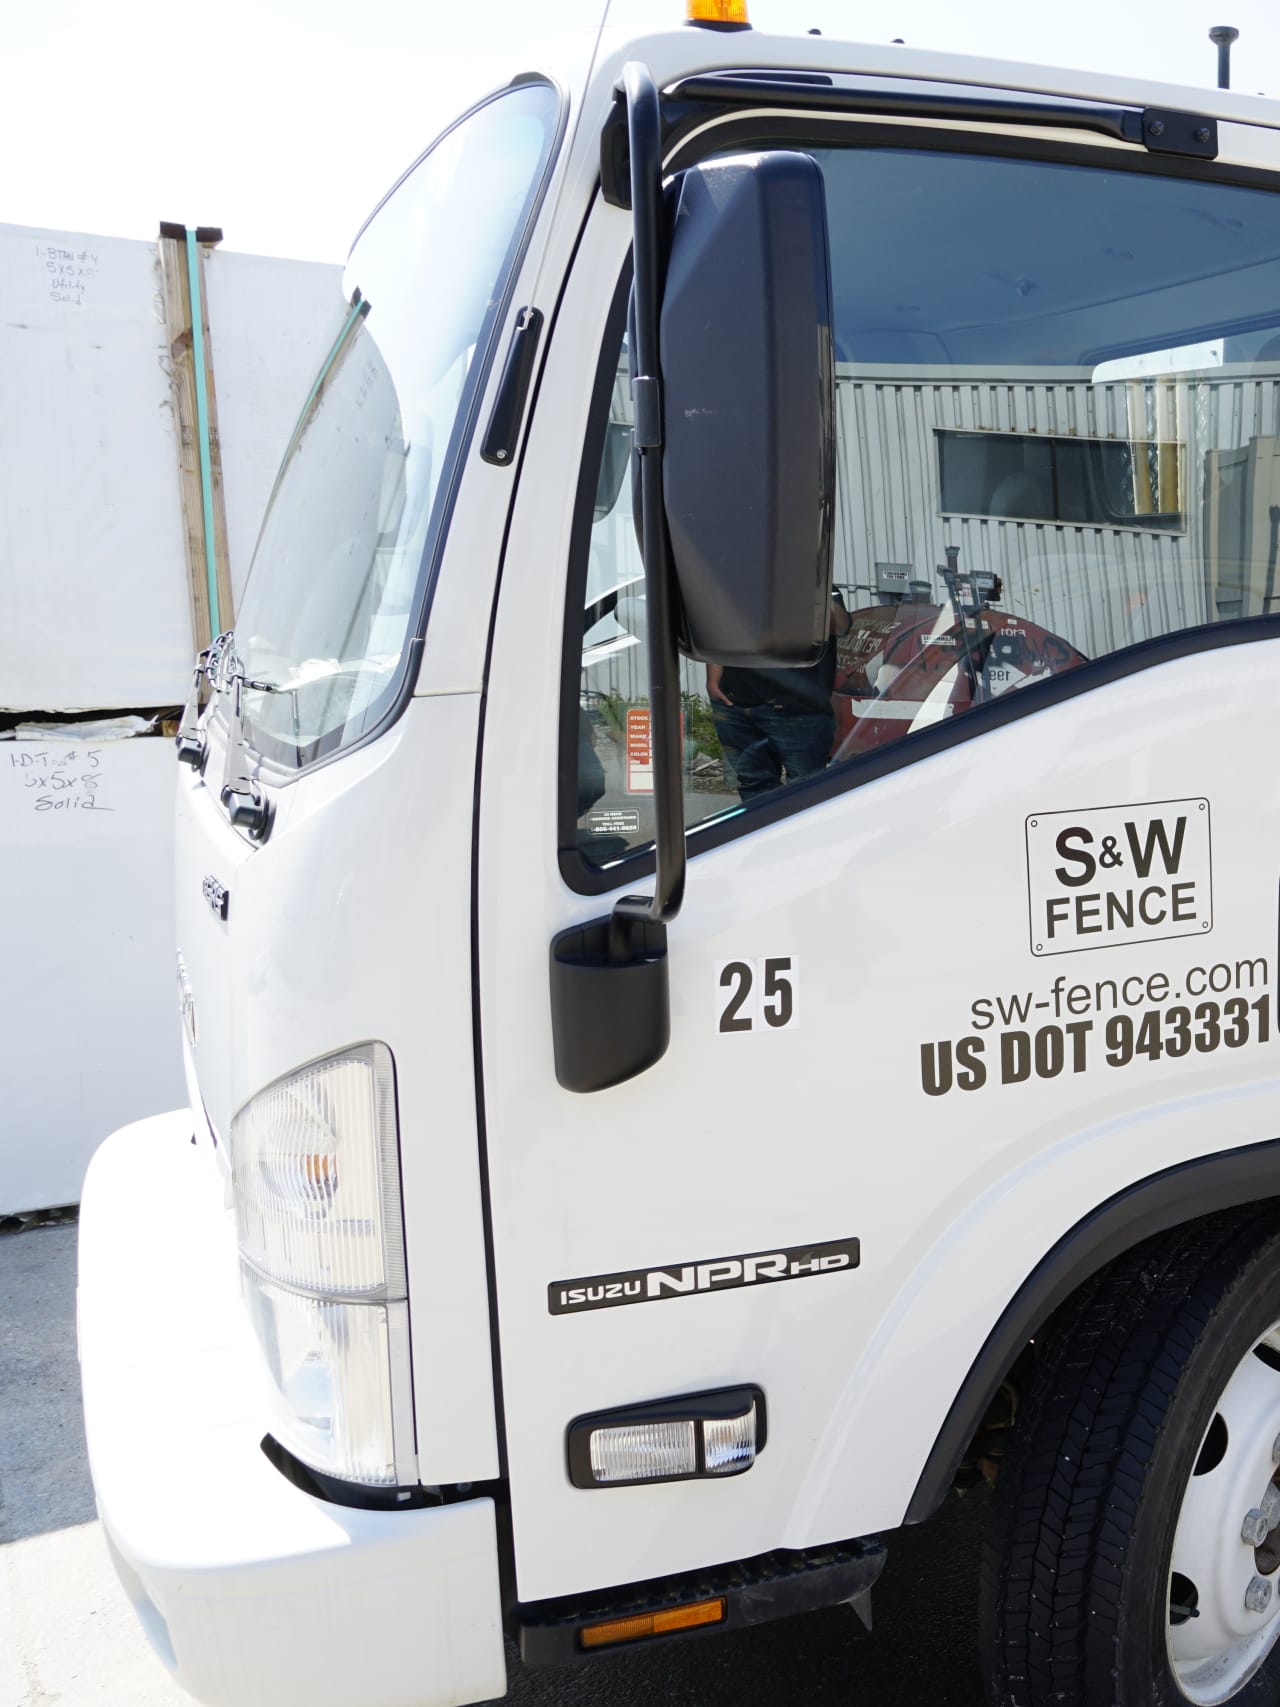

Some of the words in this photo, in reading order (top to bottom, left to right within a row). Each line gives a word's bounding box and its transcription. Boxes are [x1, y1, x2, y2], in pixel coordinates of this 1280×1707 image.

[34, 794, 115, 811] Solid
[1054, 816, 1188, 887] S&W
[1046, 881, 1197, 939] FENCE
[718, 957, 793, 1033] 25
[970, 957, 1269, 1030] sw-fence.com
[920, 1036, 987, 1097] US
[1000, 1020, 1094, 1085] DOT
[1105, 993, 1271, 1068] 943331
[560, 1280, 641, 1306] ISUZU
[646, 1253, 788, 1297] NPR
[790, 1253, 850, 1276] HD
